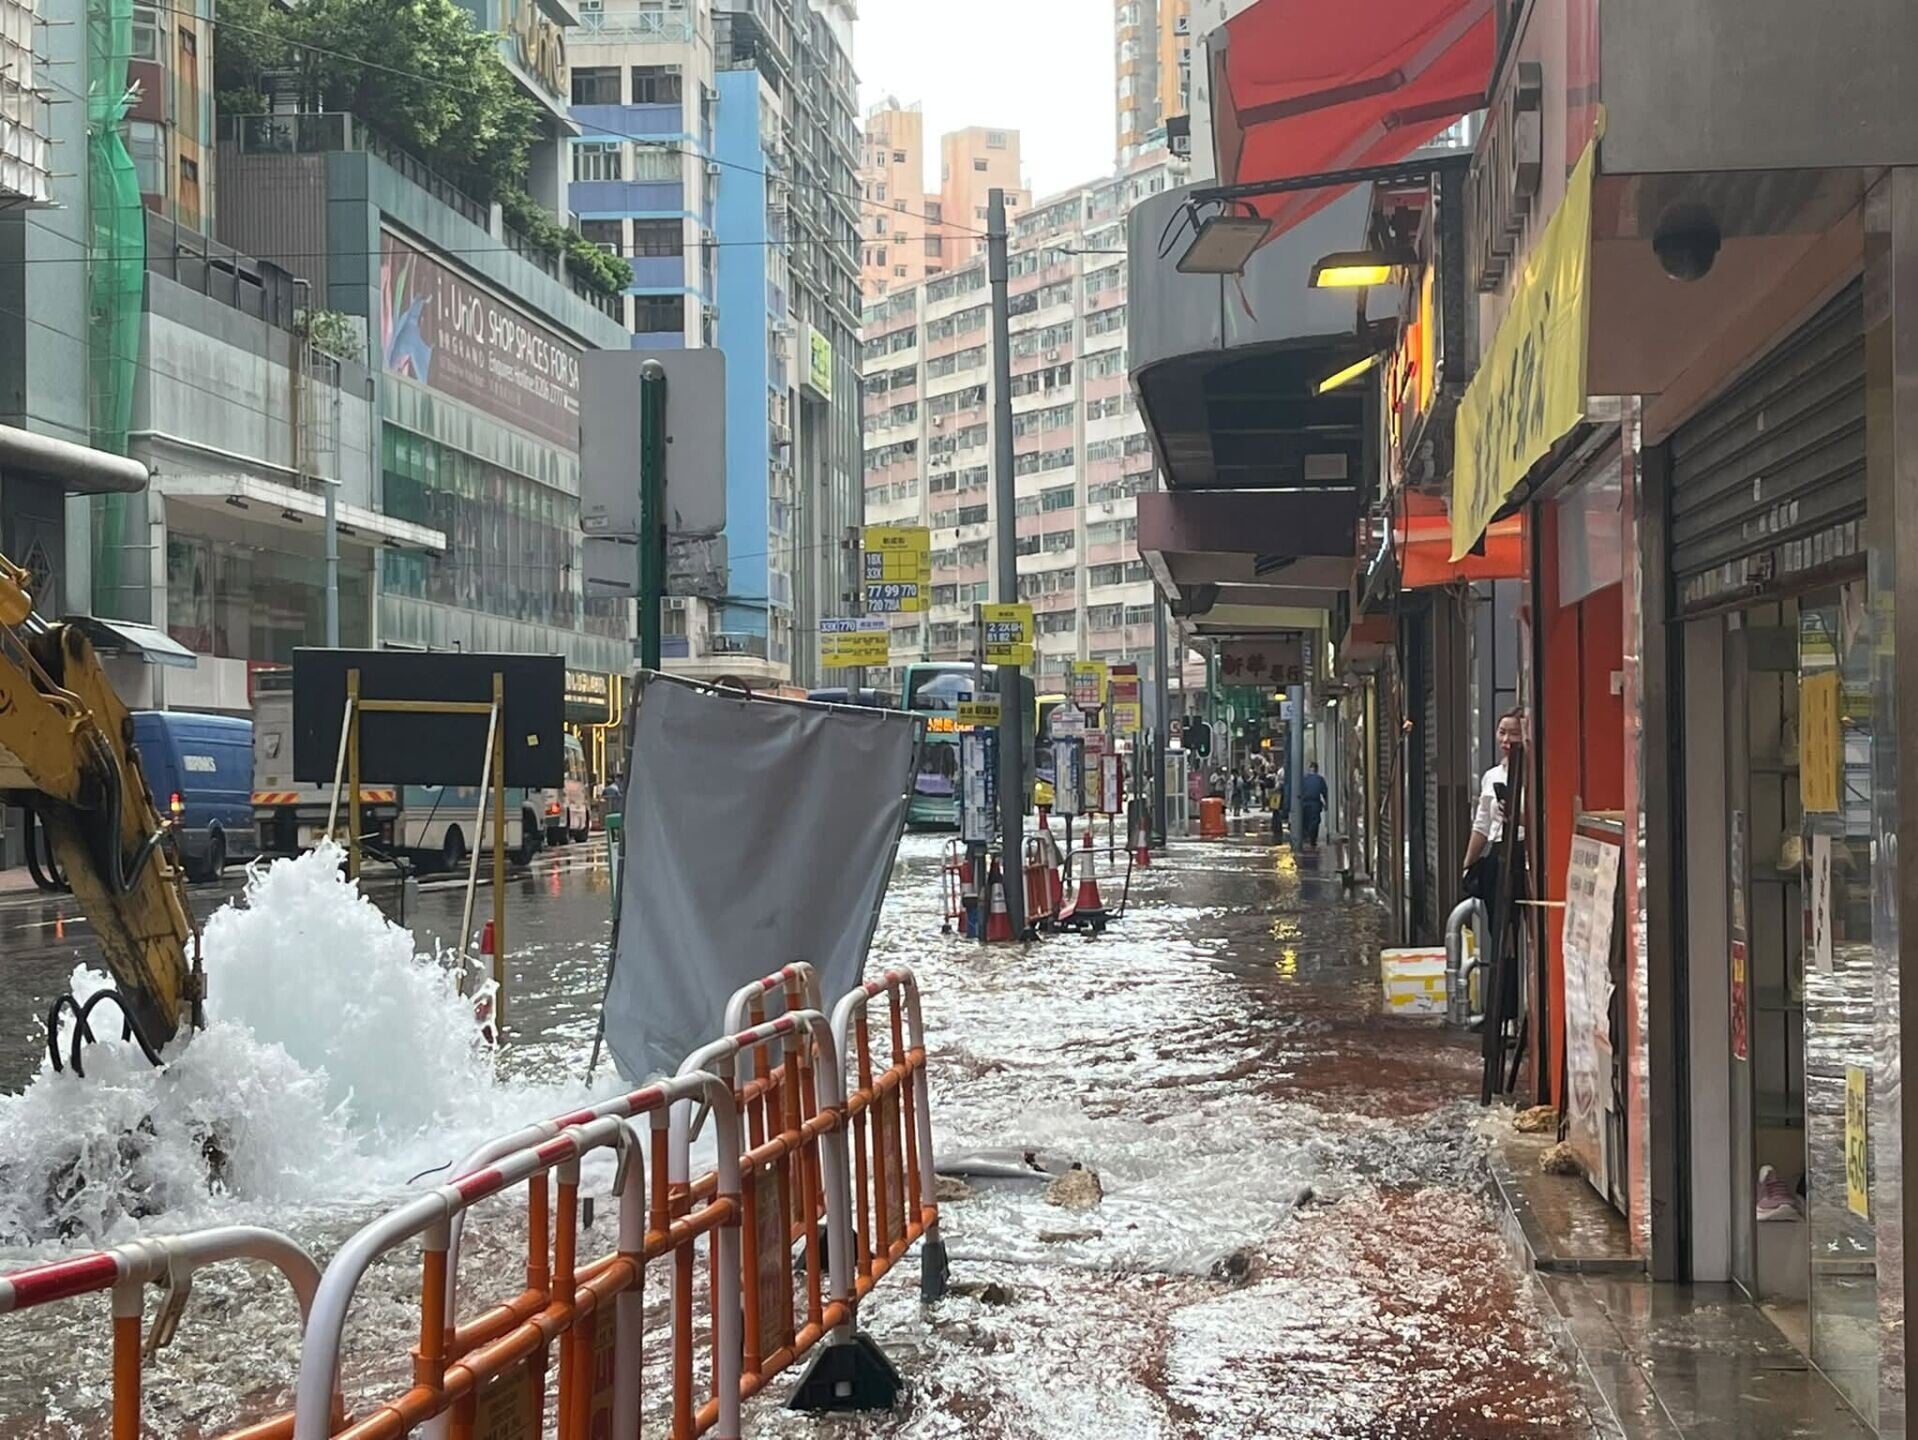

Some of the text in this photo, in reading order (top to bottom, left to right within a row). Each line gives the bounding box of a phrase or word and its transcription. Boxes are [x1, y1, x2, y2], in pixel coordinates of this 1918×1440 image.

[488, 309, 515, 352] SHOP
[515, 325, 549, 374] SPACES
[550, 346, 568, 382] FOR
[867, 584, 917, 598] 77 99 770
[869, 599, 884, 612] 720
[839, 620, 857, 632] 770
[989, 623, 997, 632] 2
[998, 622, 1010, 632] 2X
